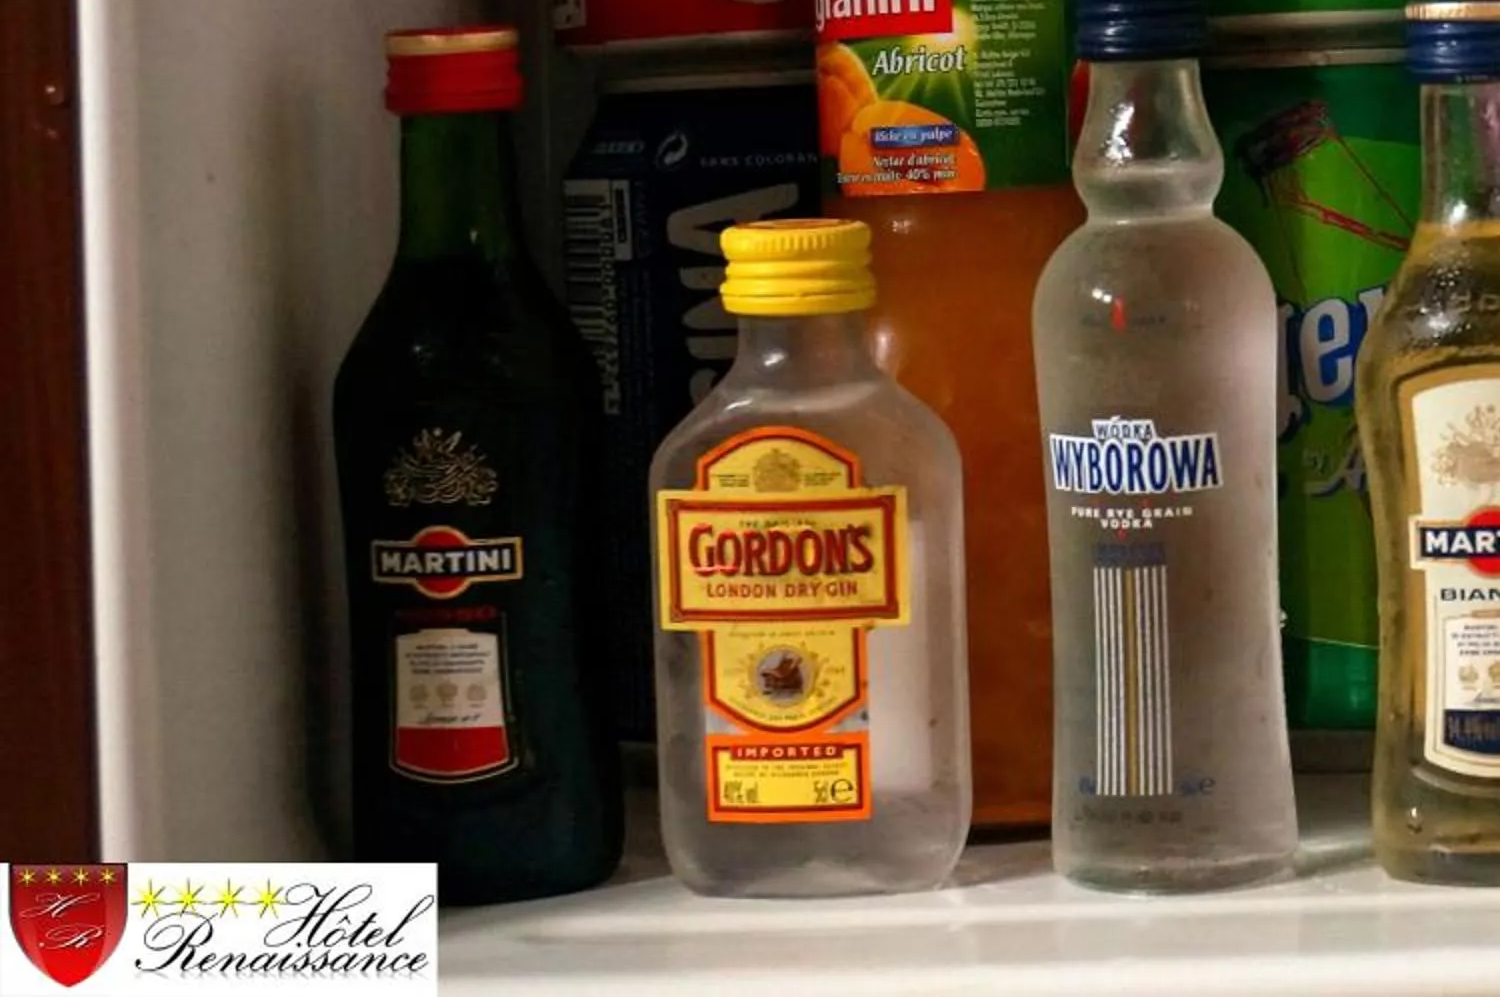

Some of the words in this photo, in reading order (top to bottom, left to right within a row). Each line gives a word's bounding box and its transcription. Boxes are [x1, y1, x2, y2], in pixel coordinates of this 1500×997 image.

[872, 45, 968, 76] Abricot
[1051, 437, 1220, 491] WYBOROWA
[1070, 505, 1101, 519] PURE
[1141, 506, 1194, 519] GRAIN
[1100, 518, 1154, 530] VODKA
[380, 548, 512, 576] MARTINI
[688, 522, 875, 579] GORDON'S
[706, 583, 778, 600] LONDON
[783, 581, 822, 599] DRY
[824, 580, 859, 598] GIN
[736, 745, 838, 760] IMPORTED
